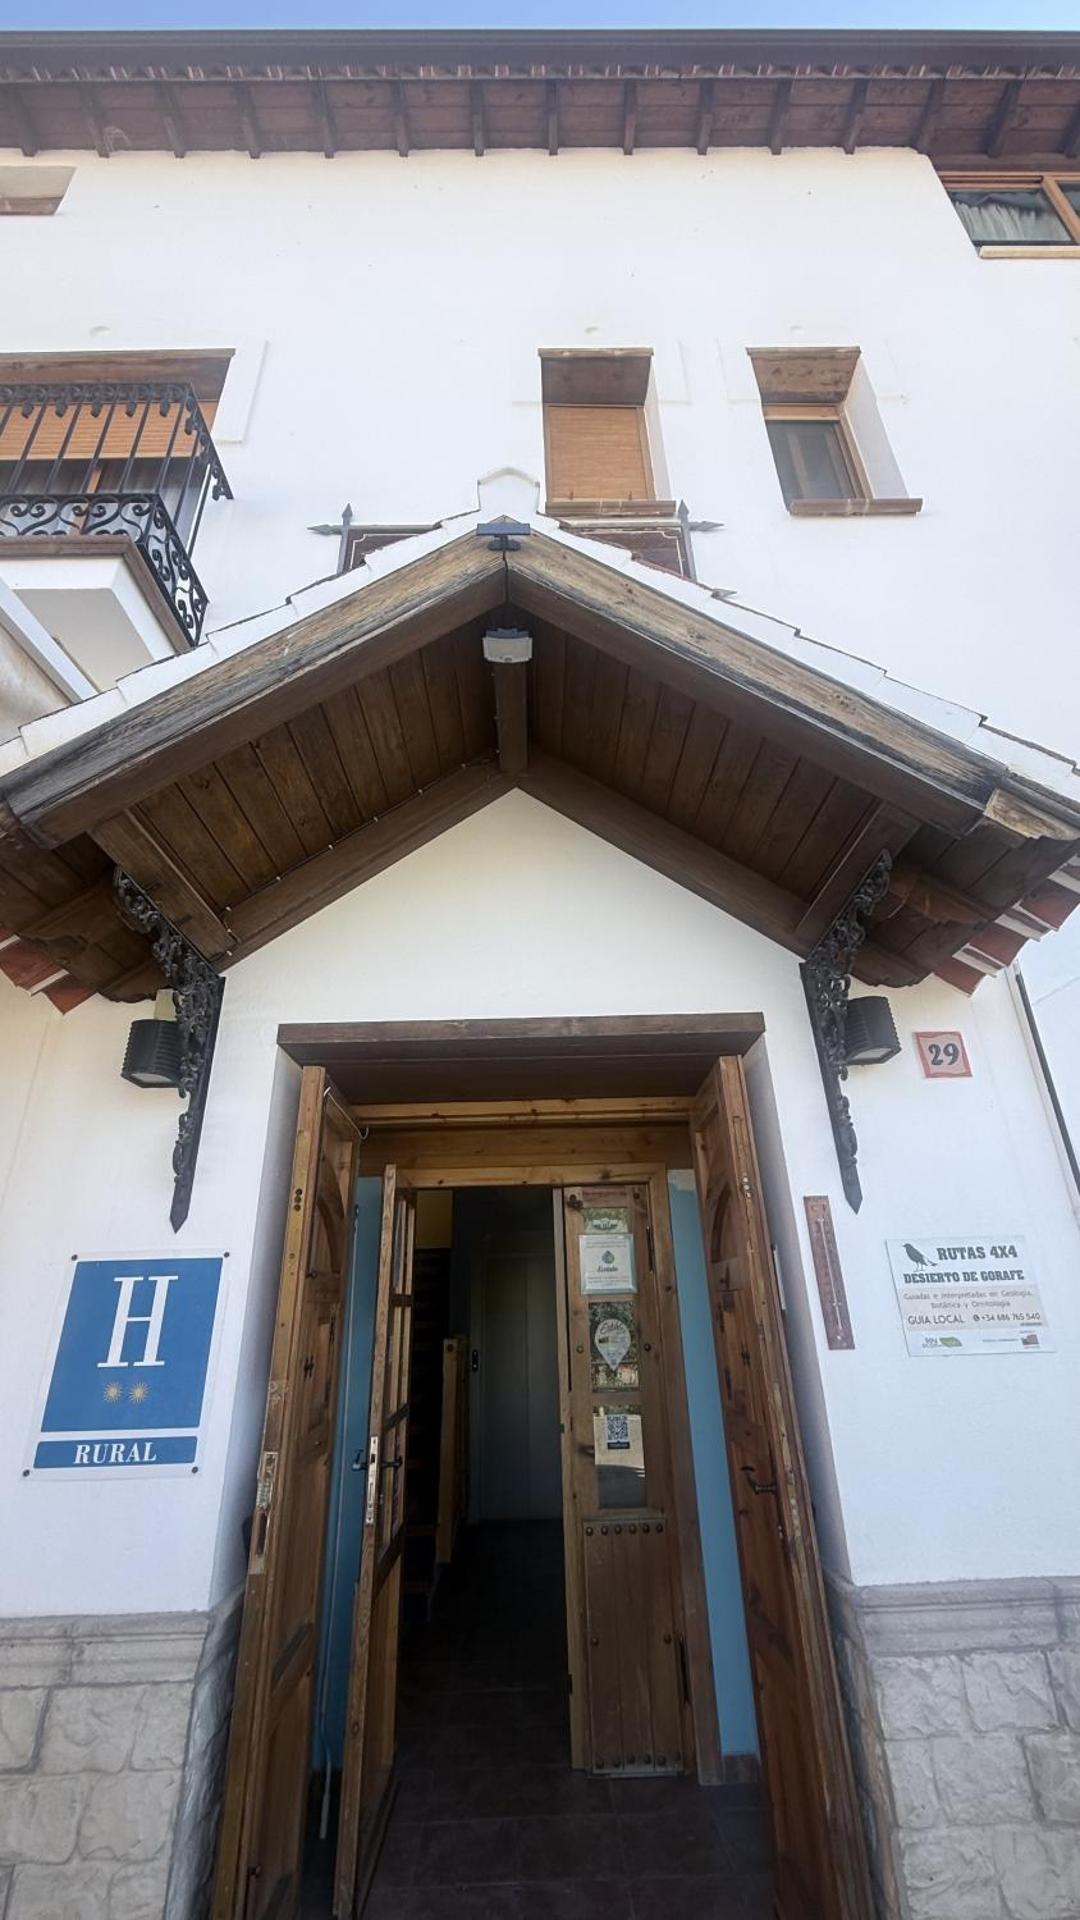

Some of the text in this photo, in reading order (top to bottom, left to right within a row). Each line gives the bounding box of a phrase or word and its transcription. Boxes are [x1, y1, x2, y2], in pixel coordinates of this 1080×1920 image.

[928, 1043, 959, 1066] 29
[937, 1245, 1019, 1261] RUTAS 4X4
[903, 1269, 1025, 1284] DESIERTO DE GORAFE
[97, 1275, 179, 1368] H
[933, 1314, 965, 1324] LOCAL
[74, 1442, 157, 1464] RURAL
